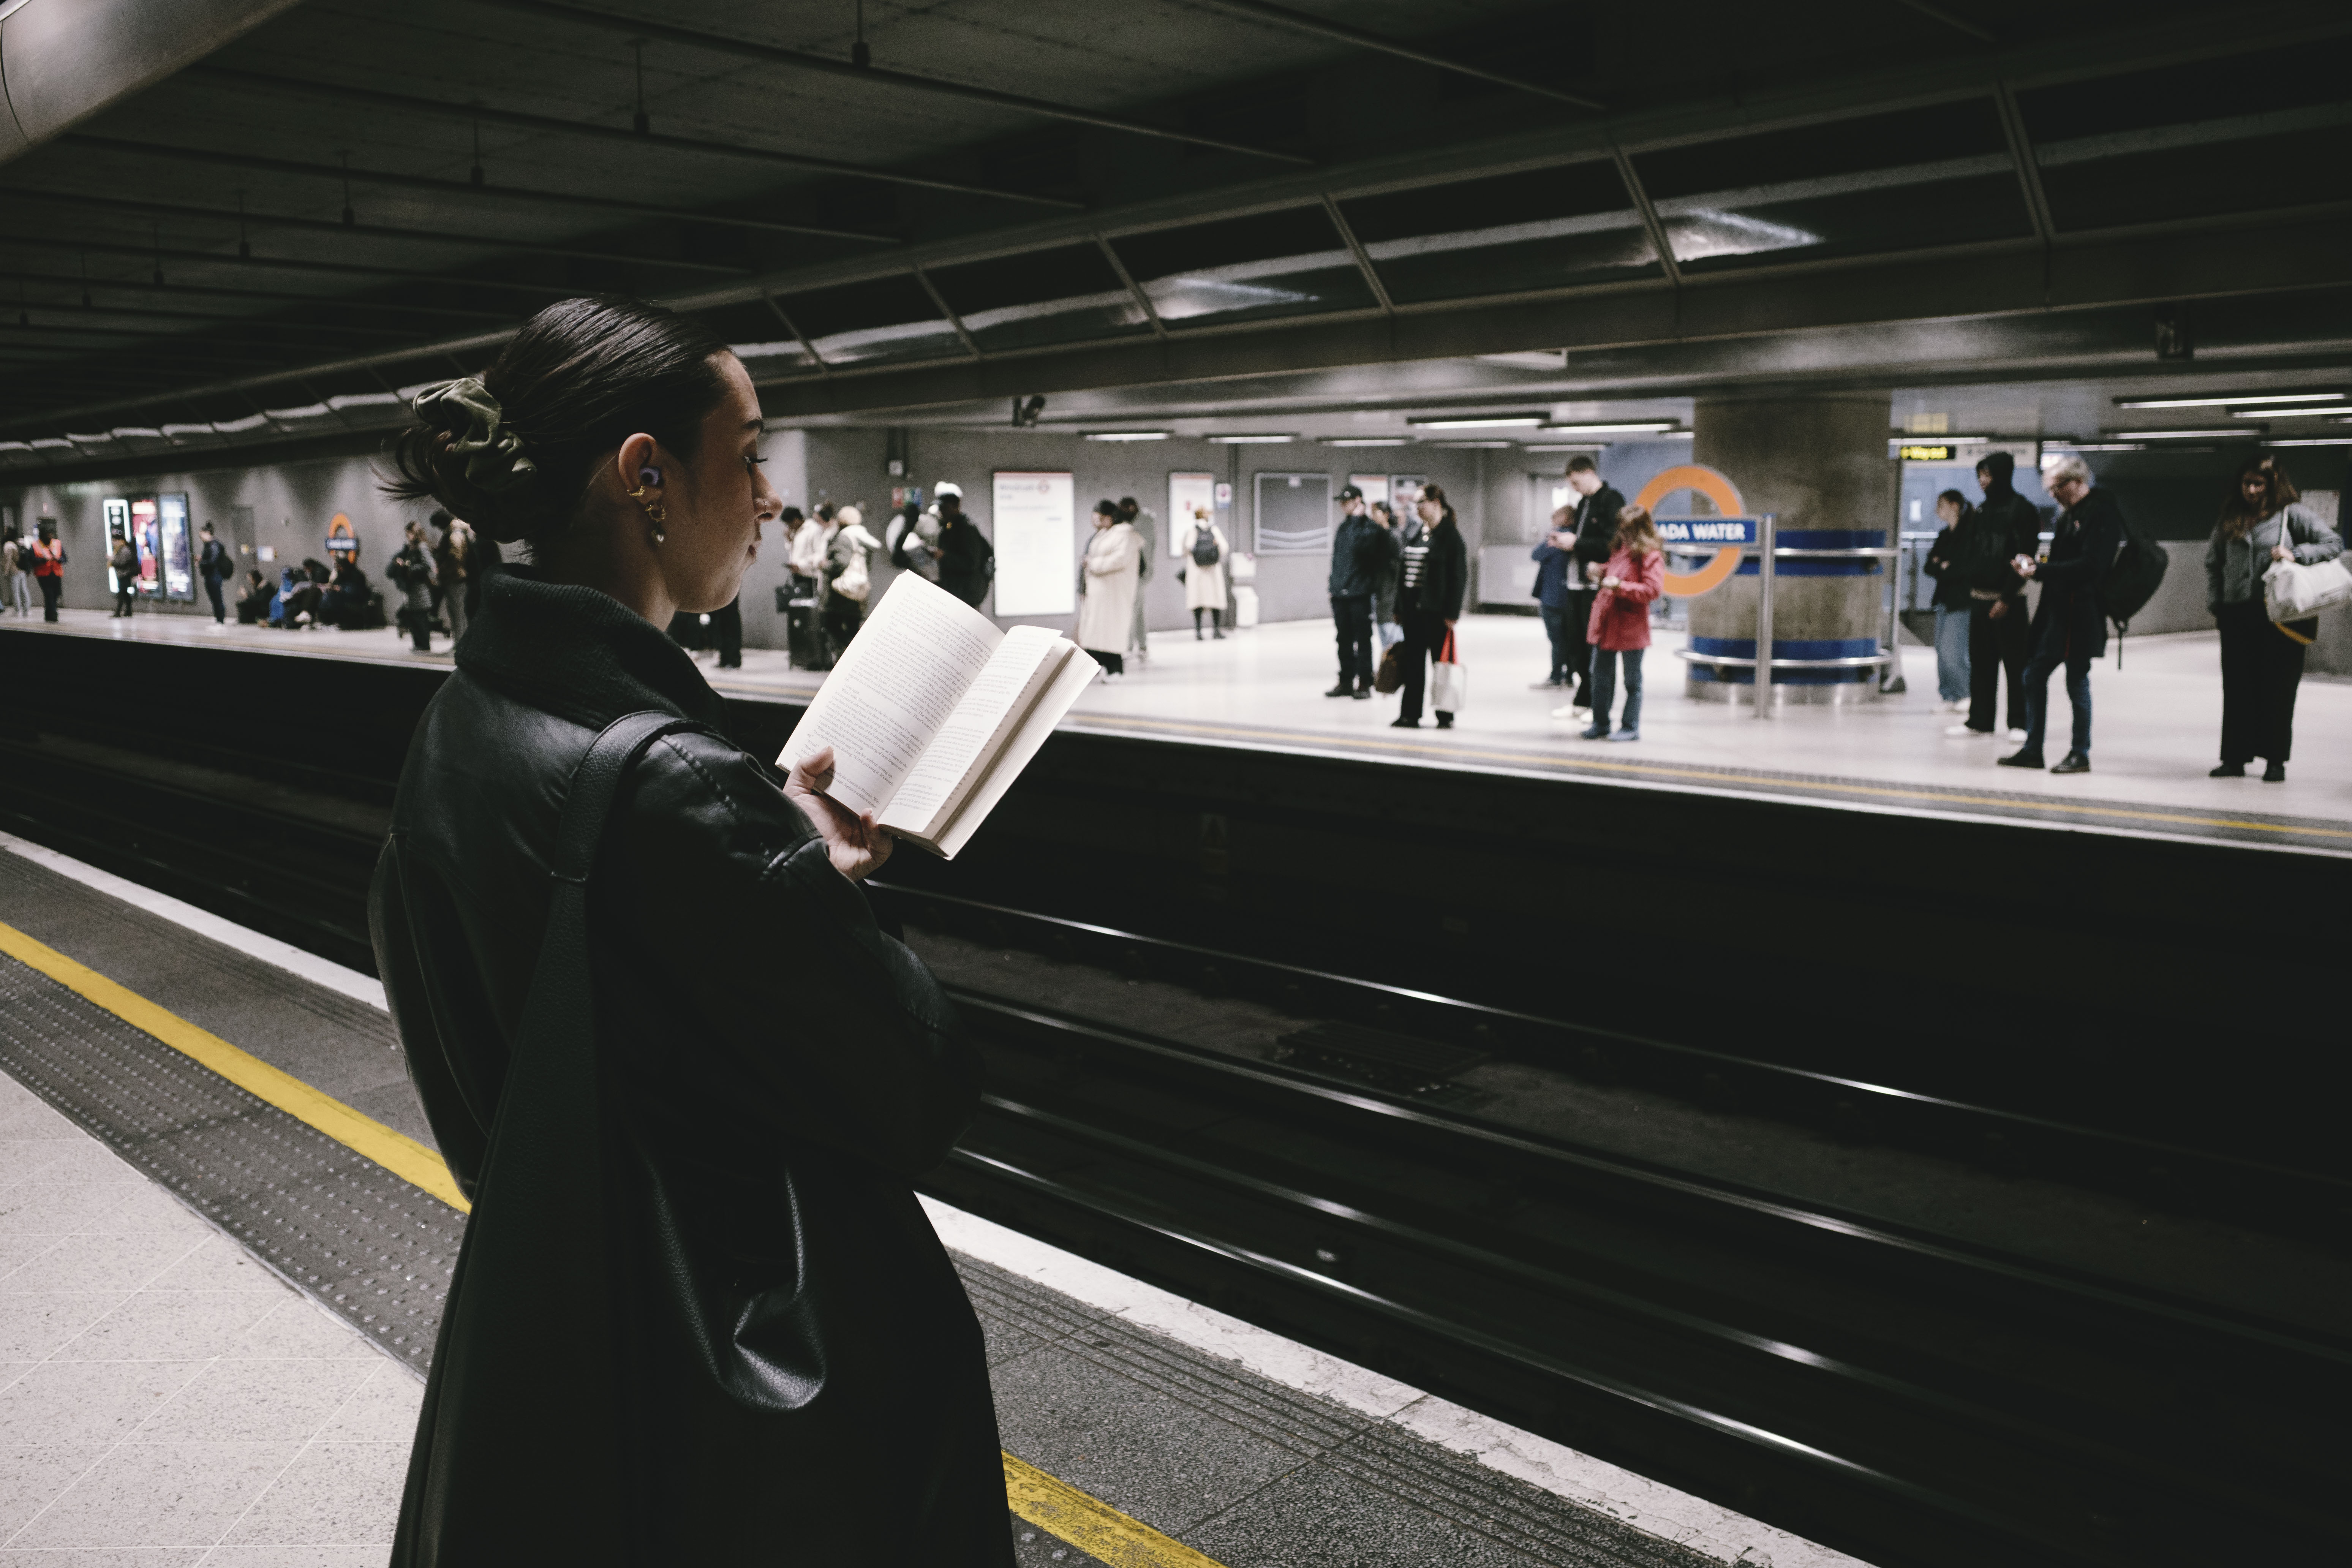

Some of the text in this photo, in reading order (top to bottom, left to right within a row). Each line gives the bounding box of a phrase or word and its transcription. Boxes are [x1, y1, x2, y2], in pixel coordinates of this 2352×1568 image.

[1691, 523, 1746, 541] WATER
[950, 632, 961, 640] myself
[947, 649, 956, 658] done
[929, 663, 940, 673] There's
[936, 662, 945, 671] angry
[949, 665, 962, 676] through
[936, 675, 949, 687] breathes
[948, 686, 957, 695] softly
[924, 687, 934, 696] beside
[913, 694, 927, 705] couldn't
[921, 692, 937, 705] happened
[912, 714, 924, 724] There's
[923, 722, 935, 734] nothing
[924, 716, 934, 724] world
[930, 714, 942, 726] nothing
[894, 721, 905, 730] knows
[910, 733, 920, 742] awake
[909, 738, 921, 752] listening
[863, 741, 878, 754] something
[887, 758, 898, 768] lingers
[890, 753, 899, 762] listen
[866, 757, 878, 767] without
[878, 766, 888, 775] sitting
[846, 778, 858, 788] Cassius
[843, 783, 856, 793] Jupiter's
[855, 792, 868, 802] soldiers
